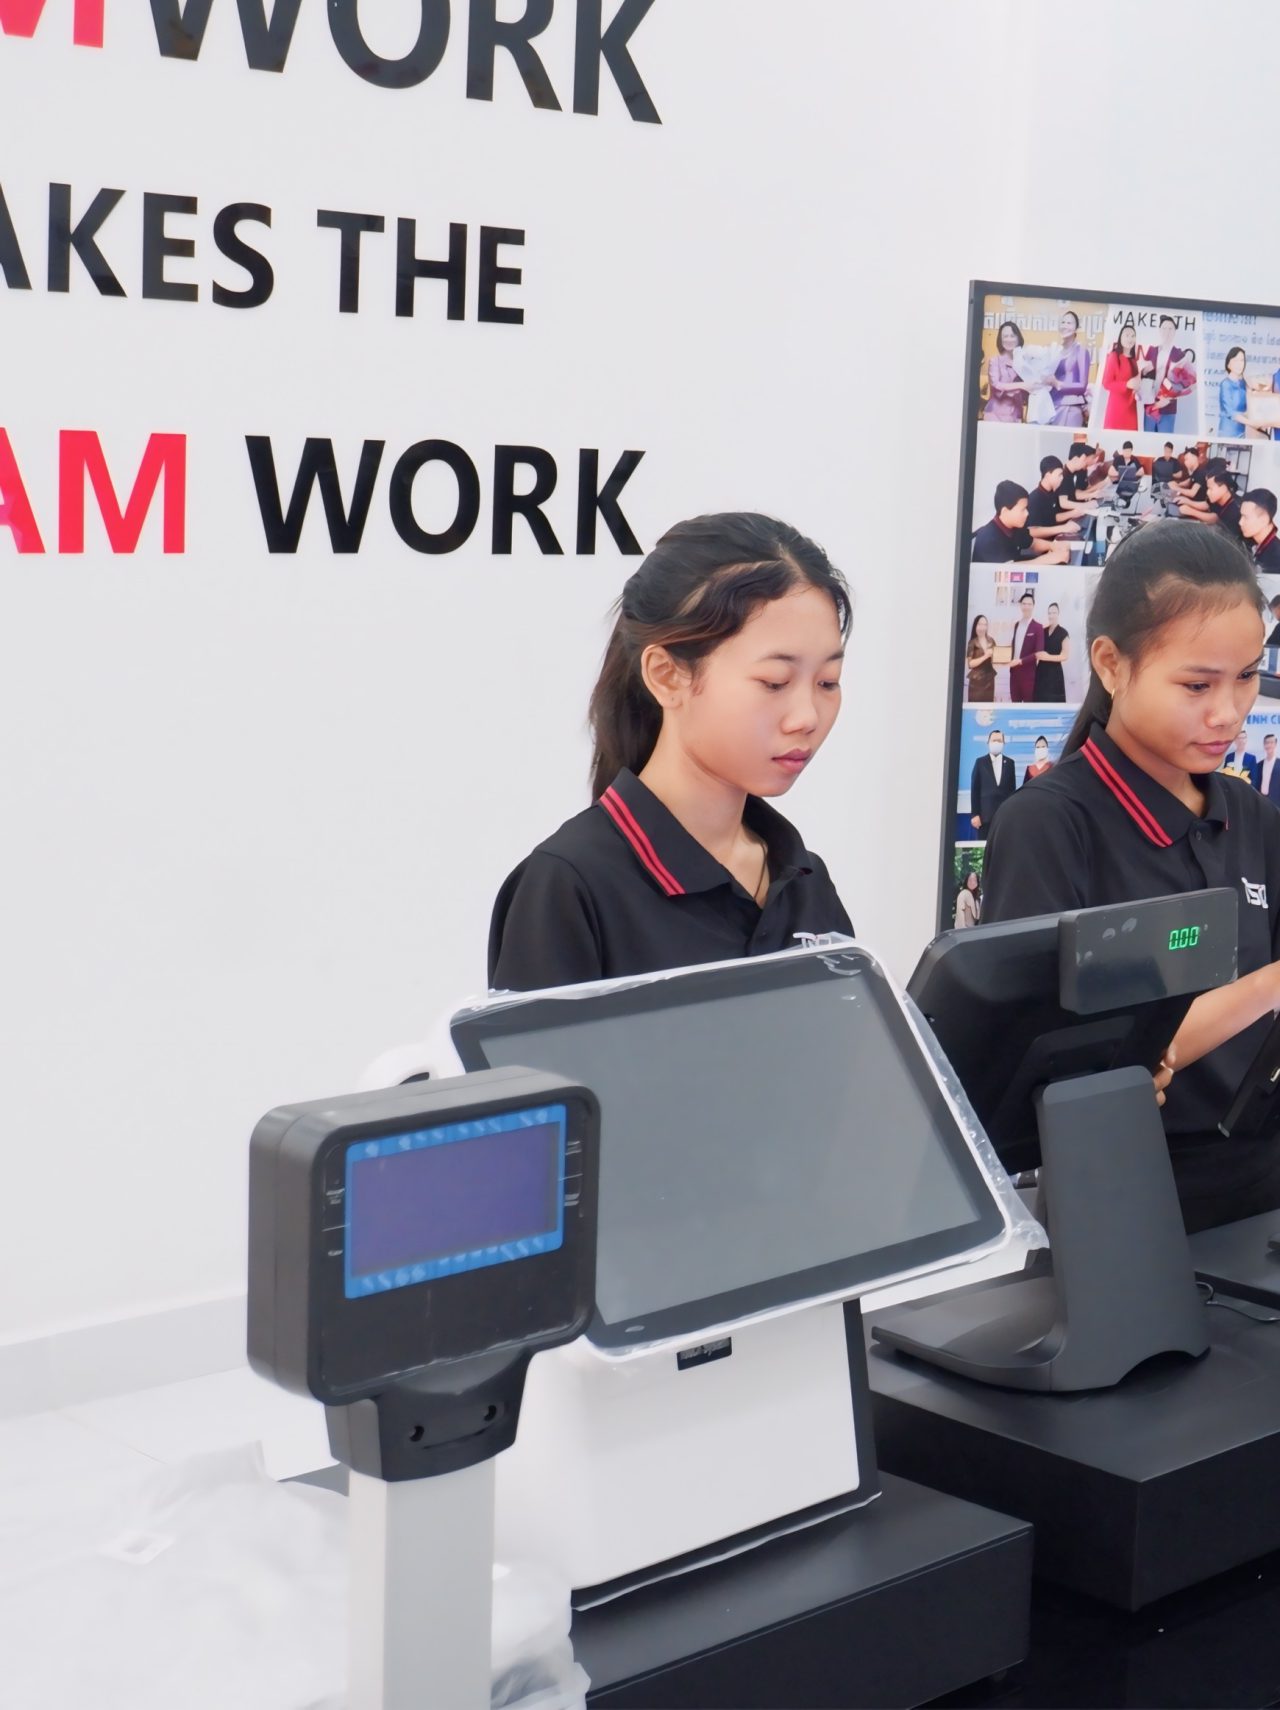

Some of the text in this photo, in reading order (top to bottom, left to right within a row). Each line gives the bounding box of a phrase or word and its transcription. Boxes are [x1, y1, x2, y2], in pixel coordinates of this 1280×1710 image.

[317, 210, 526, 325] THE
[246, 436, 646, 556] WORK
[1168, 926, 1200, 950] 0.00
